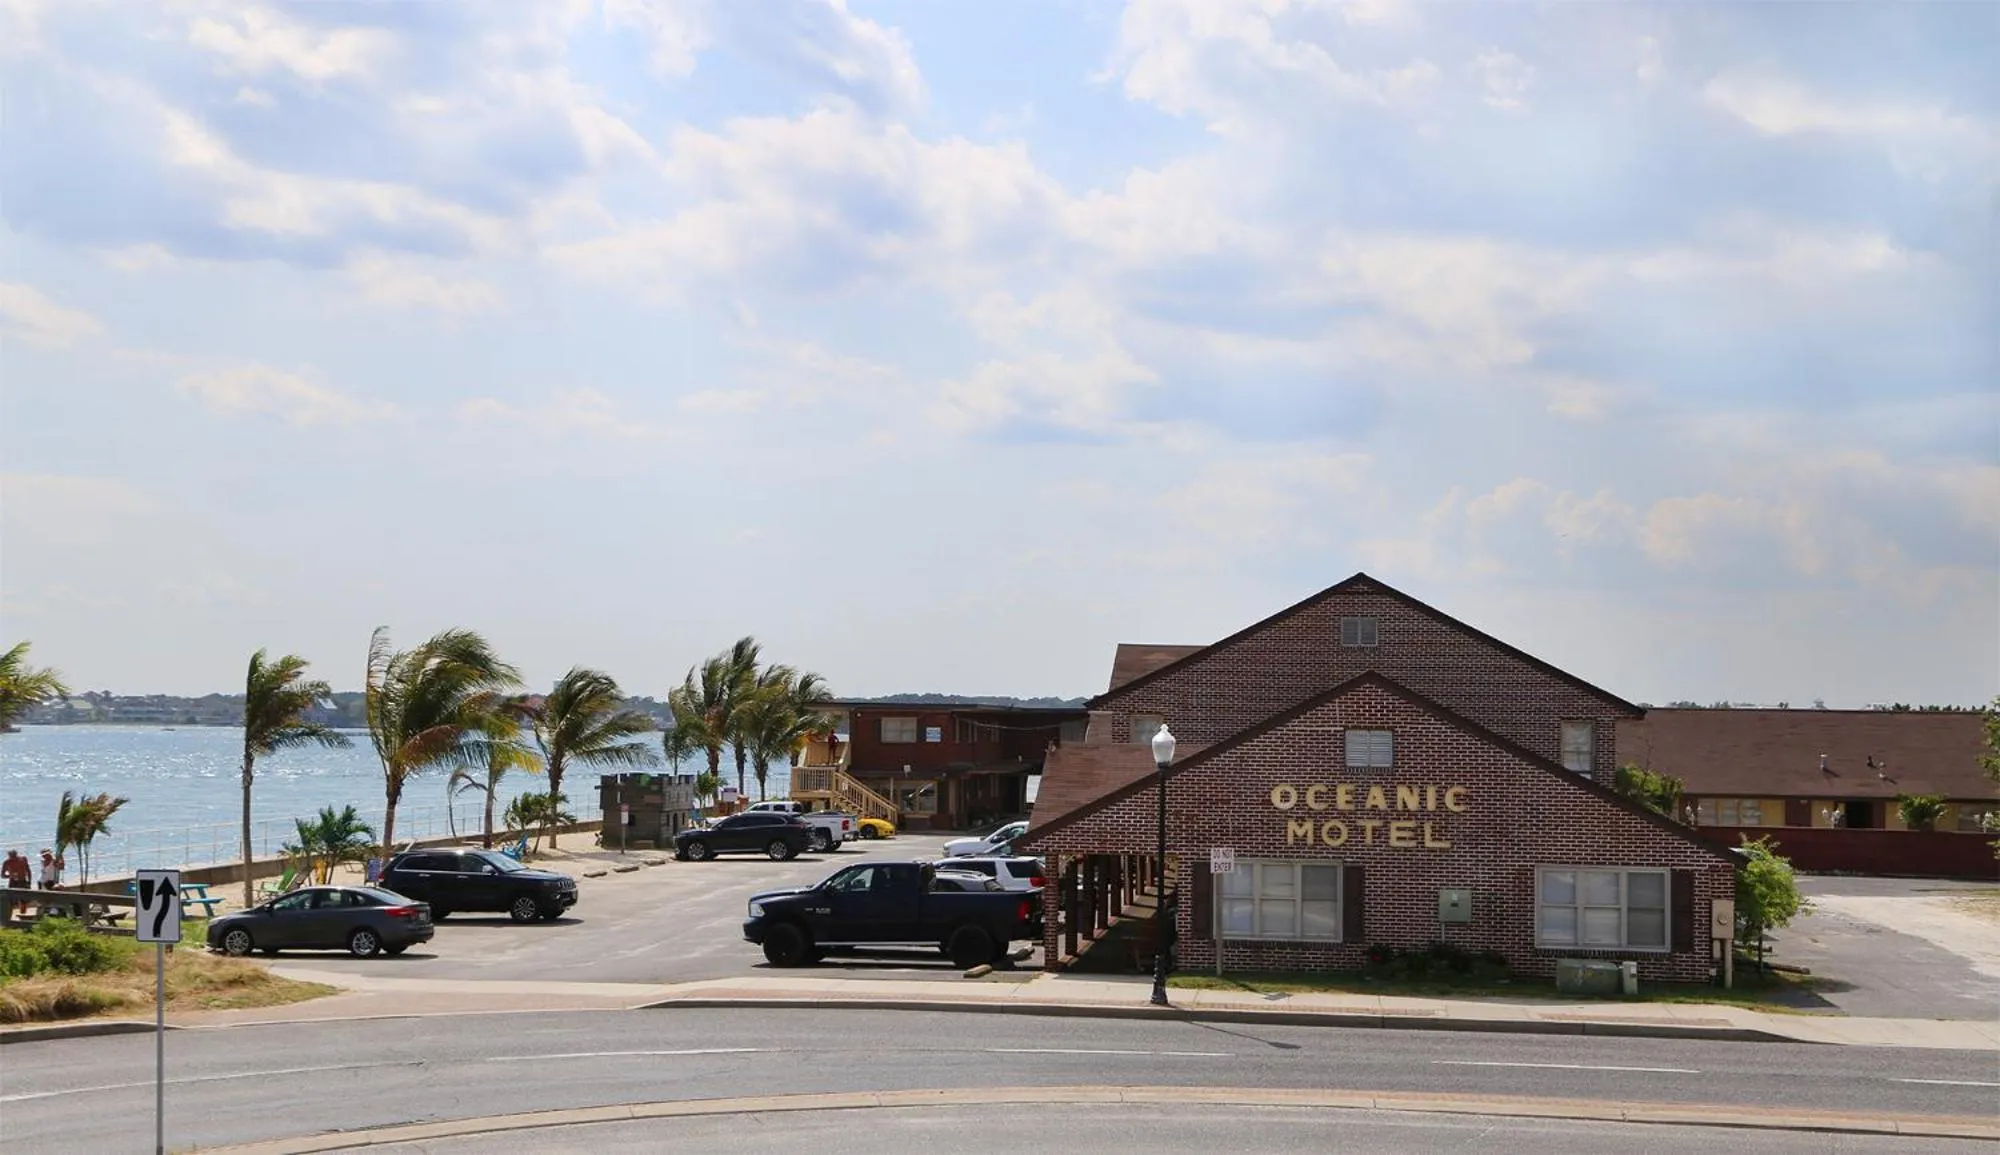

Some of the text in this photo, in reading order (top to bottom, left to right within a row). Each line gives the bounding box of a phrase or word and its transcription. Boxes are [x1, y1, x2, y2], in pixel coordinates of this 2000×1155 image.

[1271, 784, 1468, 812] OCEANIC
[1287, 820, 1452, 848] MOTEL
[1213, 849, 1232, 859] DO NOT
[1214, 862, 1232, 872] ENTER
